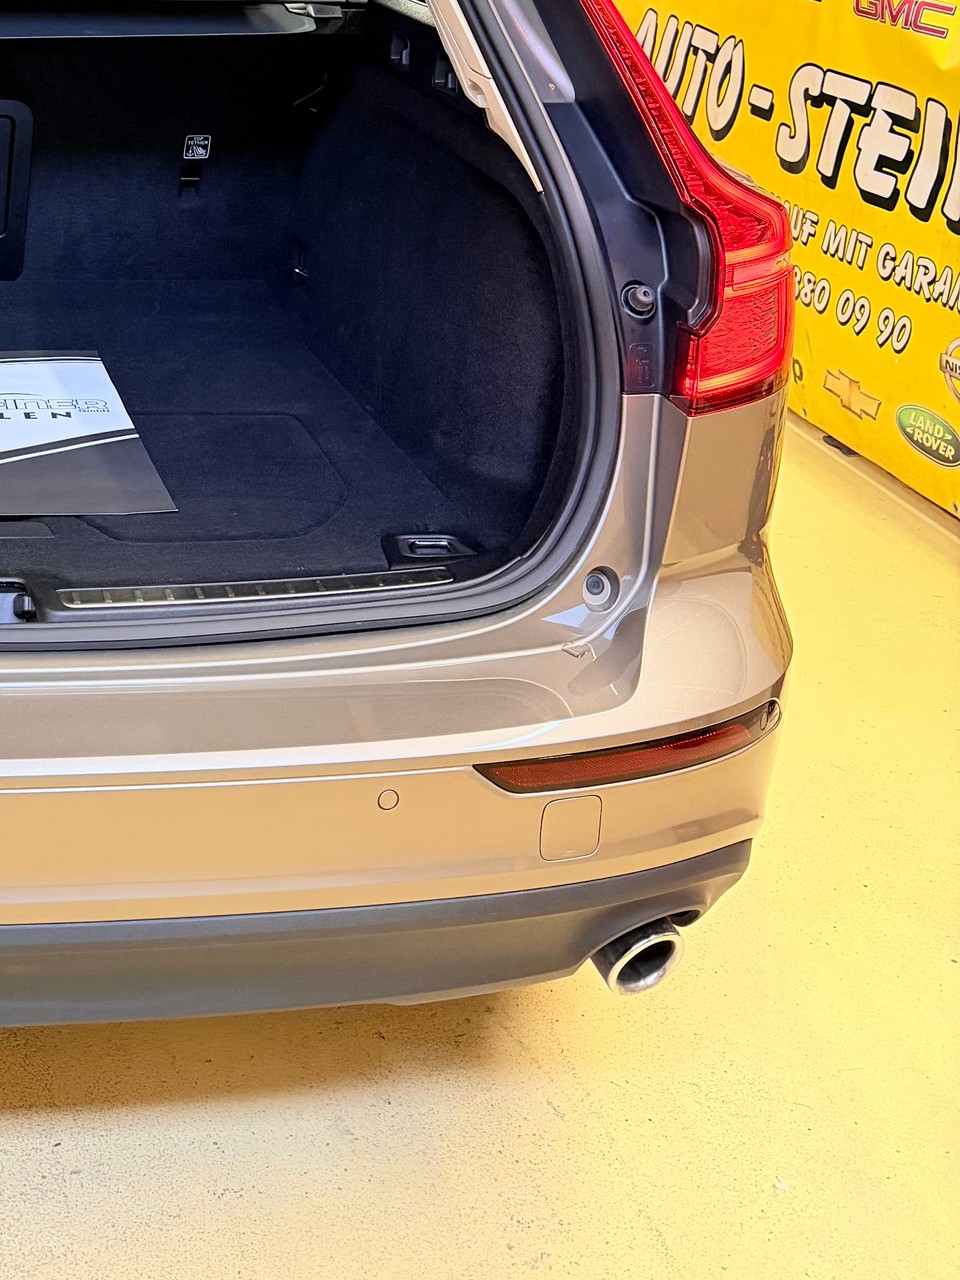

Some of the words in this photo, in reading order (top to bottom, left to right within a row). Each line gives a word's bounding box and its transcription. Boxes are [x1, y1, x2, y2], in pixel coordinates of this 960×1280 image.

[821, 219, 873, 270] MIT
[836, 289, 871, 336] 09
[876, 307, 912, 354] 90
[909, 411, 946, 438] LAND
[913, 428, 956, 461] ROVER
